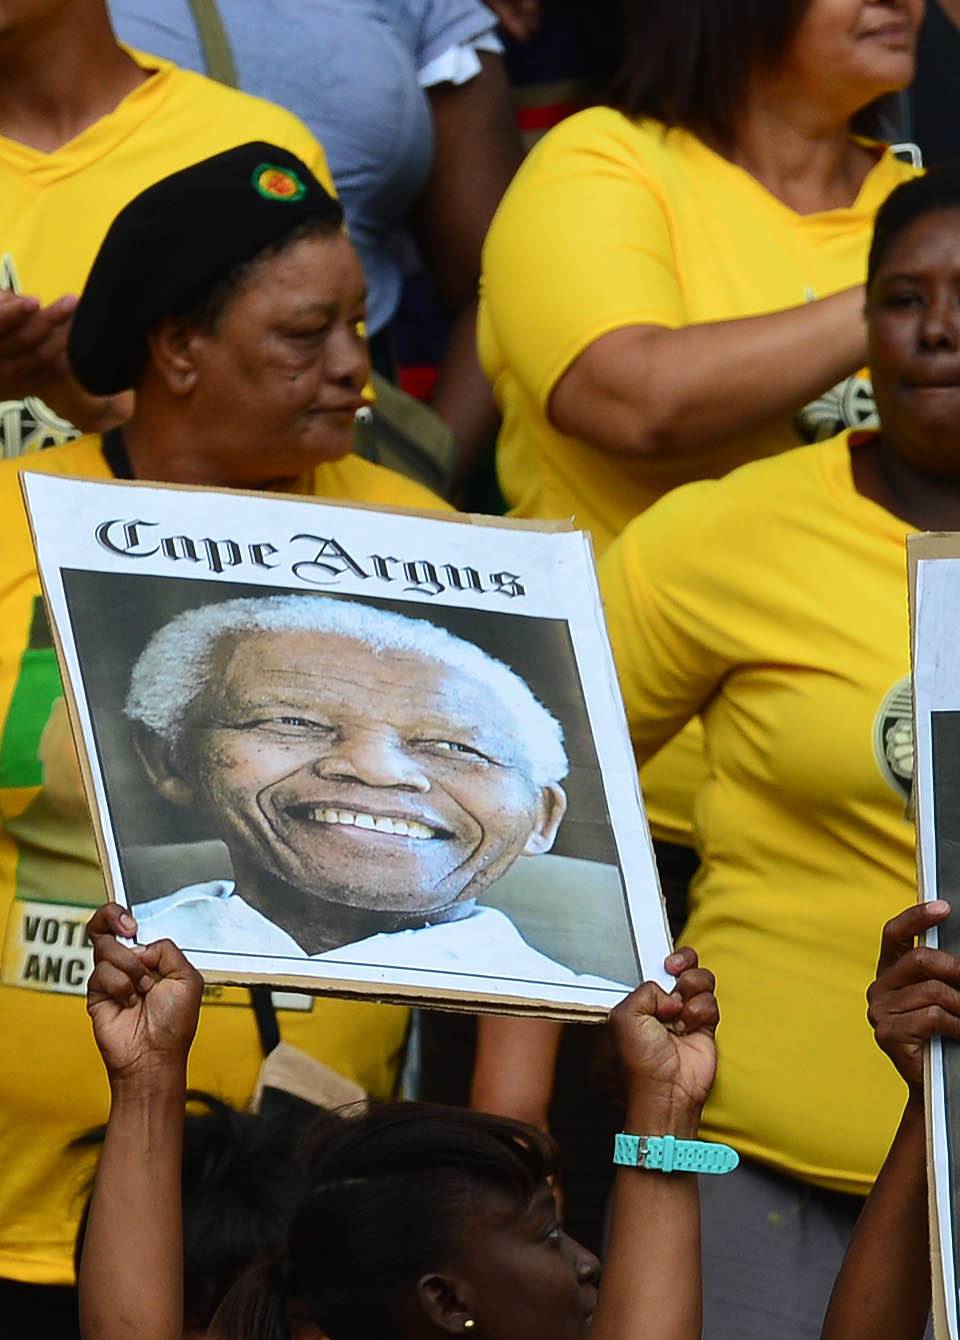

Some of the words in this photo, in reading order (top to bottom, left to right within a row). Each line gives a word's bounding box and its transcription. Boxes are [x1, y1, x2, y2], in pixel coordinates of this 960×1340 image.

[94, 518, 280, 574] Cape
[289, 533, 527, 598] Argus
[23, 953, 86, 987] ANC
